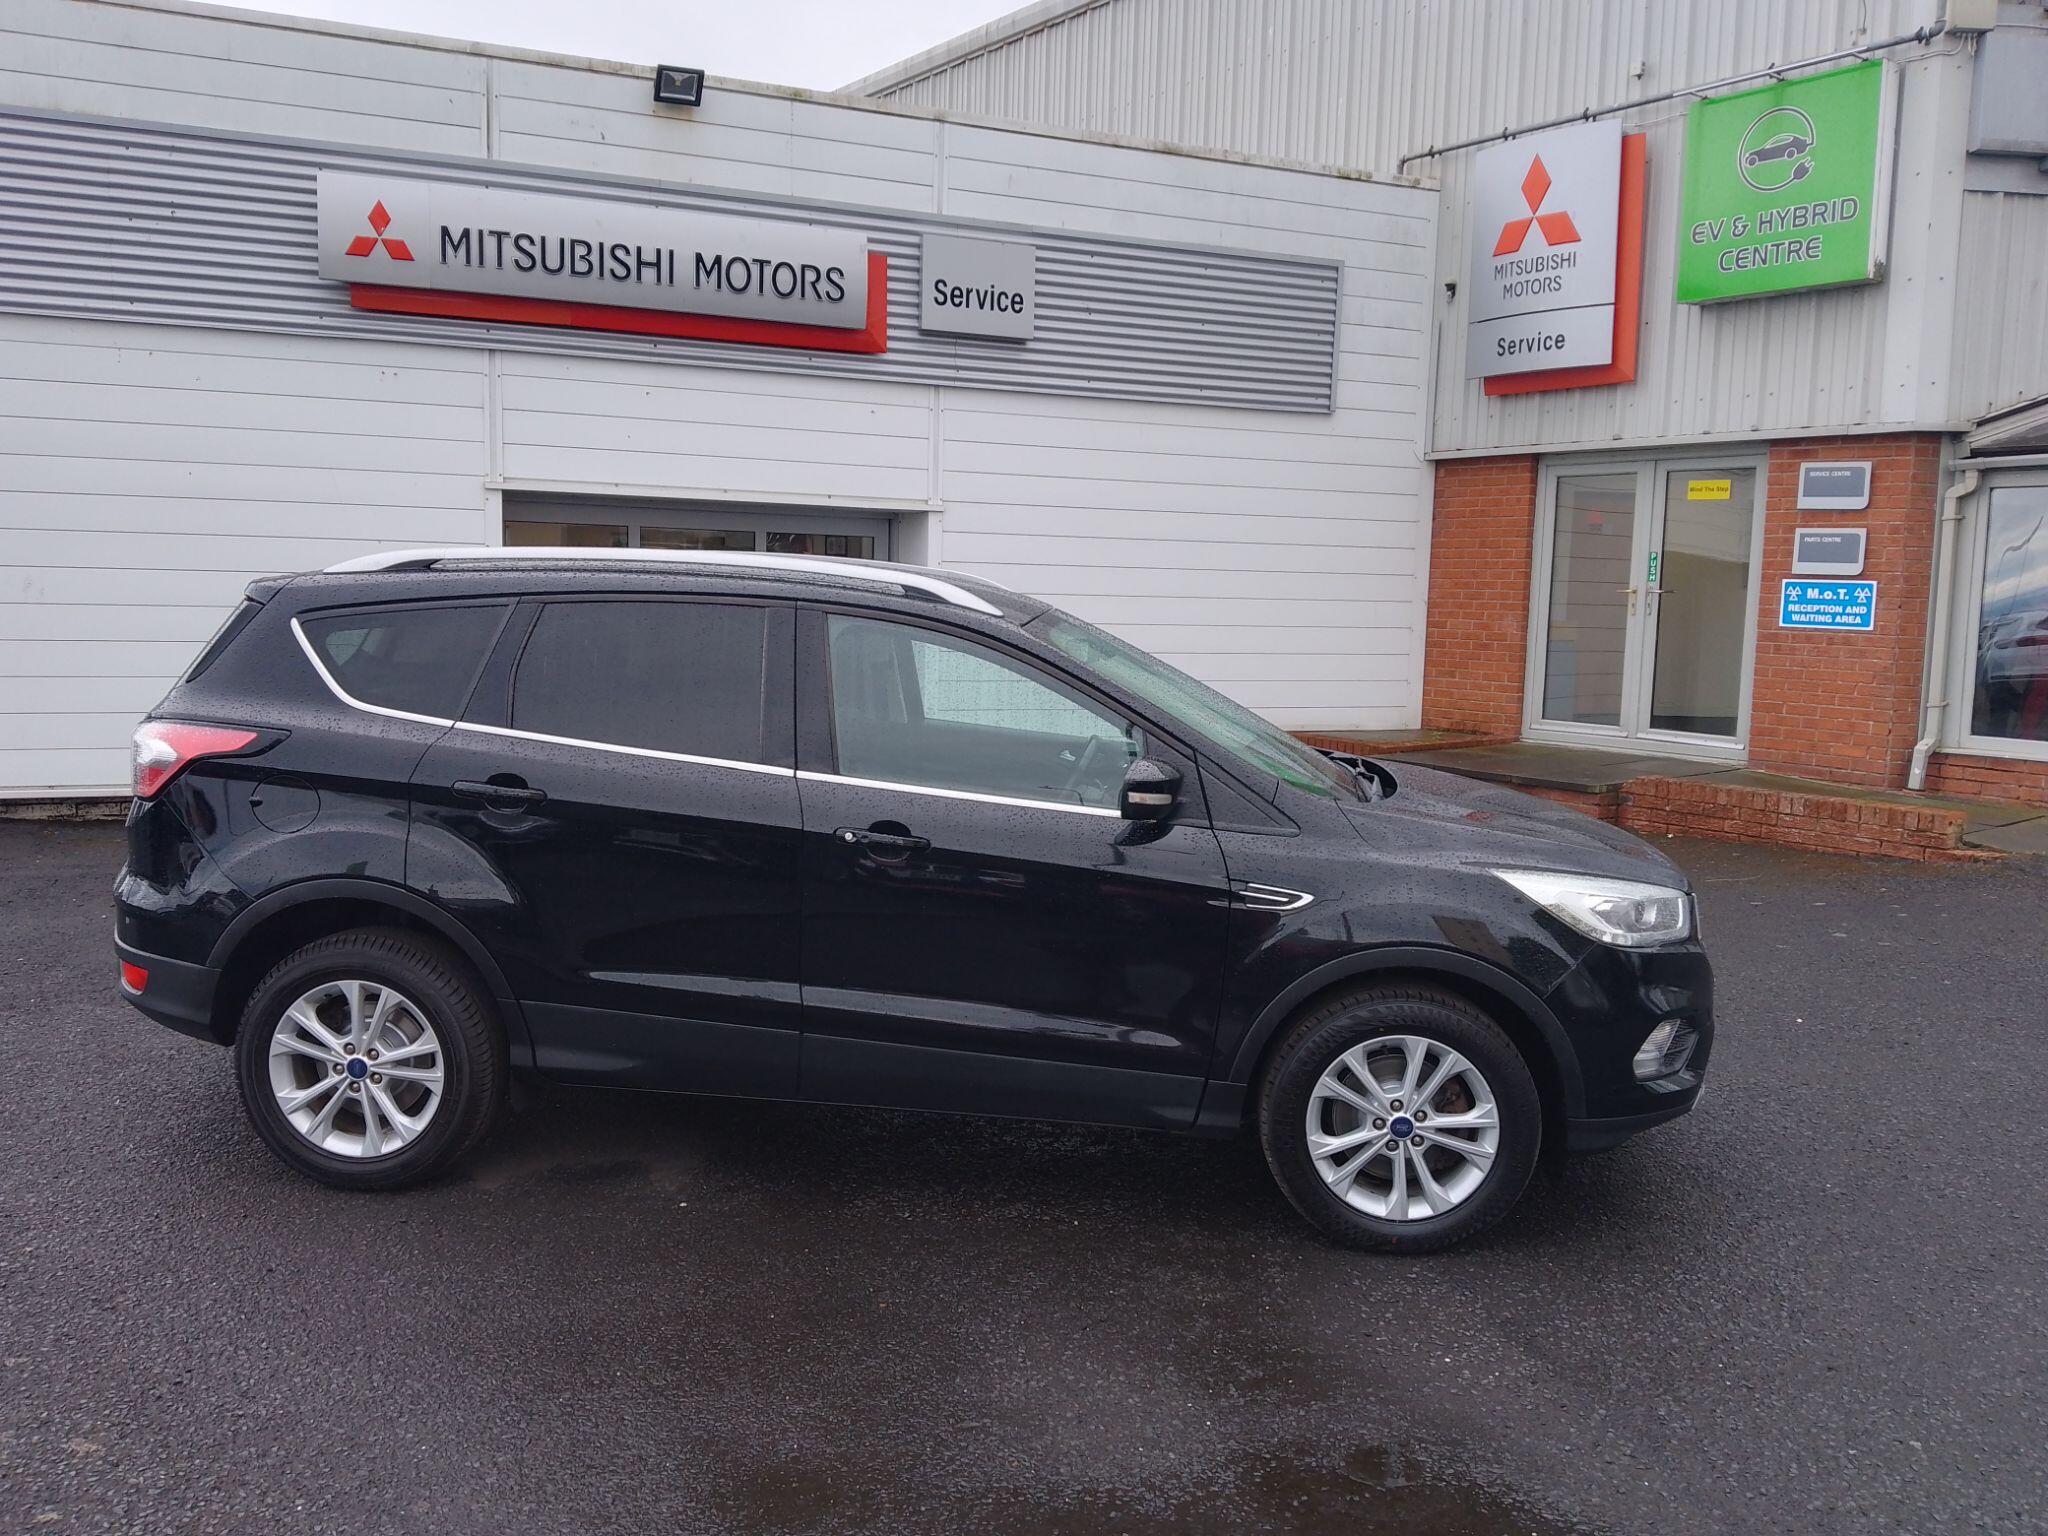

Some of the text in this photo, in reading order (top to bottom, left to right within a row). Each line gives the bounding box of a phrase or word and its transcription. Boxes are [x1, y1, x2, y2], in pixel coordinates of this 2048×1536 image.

[1691, 197, 1860, 246] EV & HYBRID
[440, 225, 845, 302] MITSUBISHI MOTORS
[1494, 251, 1577, 281] MITSUBISHI
[1718, 236, 1823, 273] CENTRE
[933, 278, 1024, 314] Service
[1503, 275, 1562, 300] MOTORS
[1497, 330, 1566, 358] Service
[1649, 552, 1657, 581] PUSH
[1807, 588, 1849, 600] M.o.T.
[1788, 604, 1867, 614] RECEPTION AND
[1792, 613, 1862, 624] WAITING AREA
